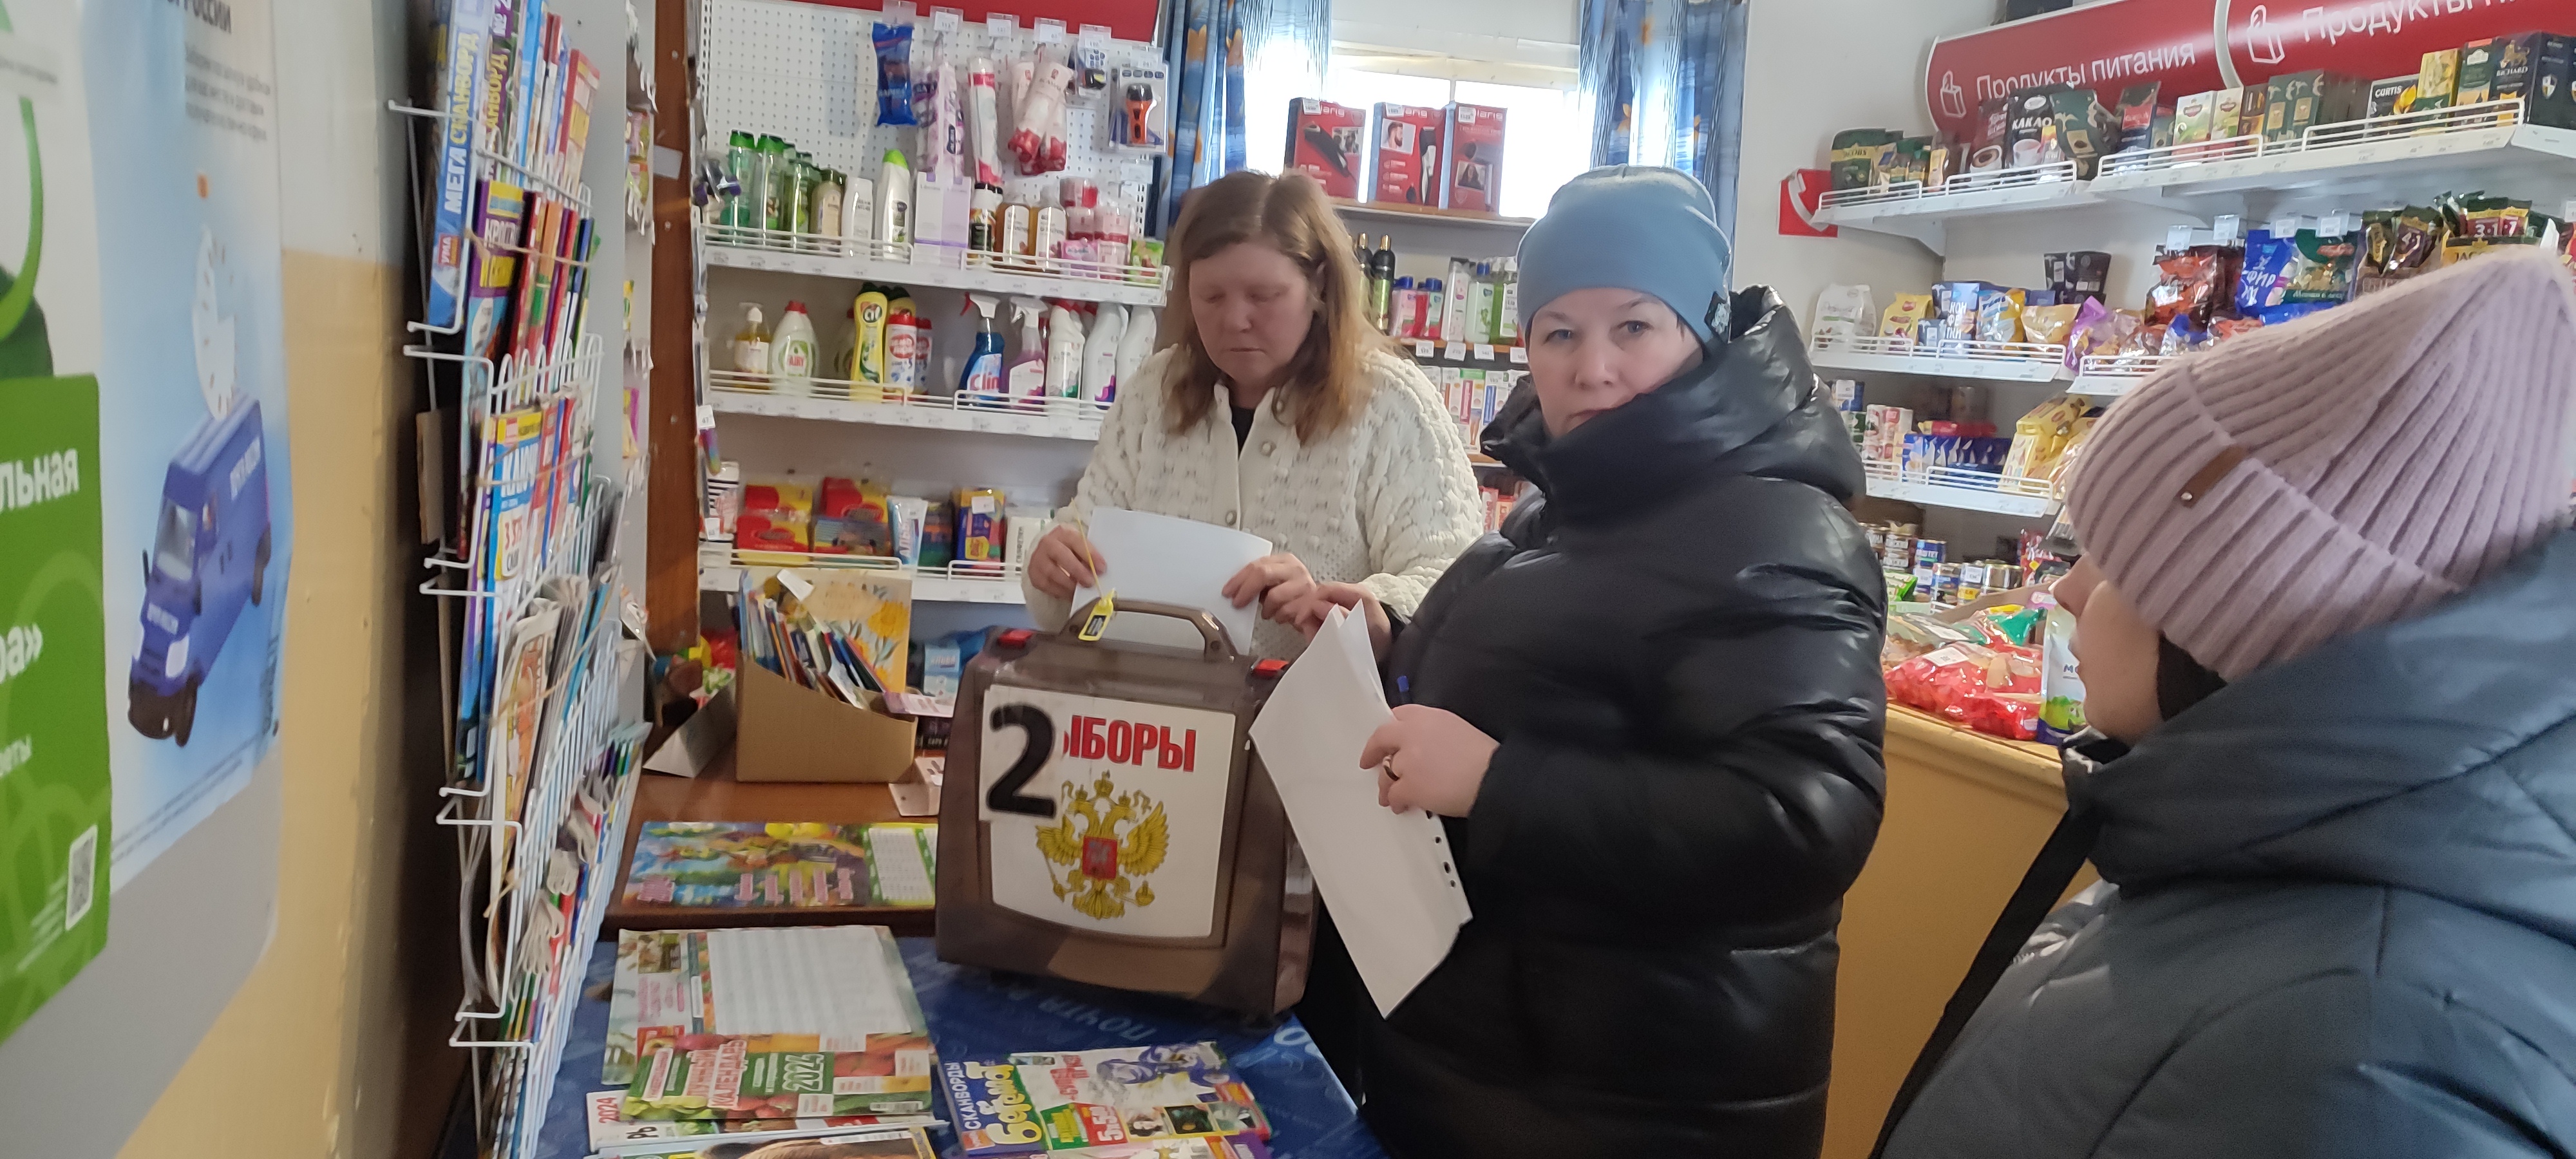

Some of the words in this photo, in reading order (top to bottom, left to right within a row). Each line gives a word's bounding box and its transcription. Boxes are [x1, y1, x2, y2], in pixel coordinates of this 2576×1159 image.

[2302, 0, 2474, 45] Продукты
[450, 33, 479, 144] СКАНВОРД
[484, 54, 509, 130] АНВОРД
[1977, 63, 2086, 100] Продукты
[2091, 42, 2196, 82] питания
[2374, 84, 2403, 98] CURTIS
[1320, 104, 1345, 117] laris
[1477, 109, 1503, 121] laris
[2012, 117, 2053, 131] КАКАО
[444, 146, 468, 214] МЕГА
[970, 372, 1000, 391] Clin
[987, 702, 1057, 819] 2
[1063, 715, 1197, 773] ЫБОРЫ
[707, 1040, 748, 1109] КАЛЕНДАРЬ
[782, 1053, 824, 1092] 2024
[945, 1062, 982, 1130] СКАНВОРДЫ
[596, 1097, 620, 1124] 2024
